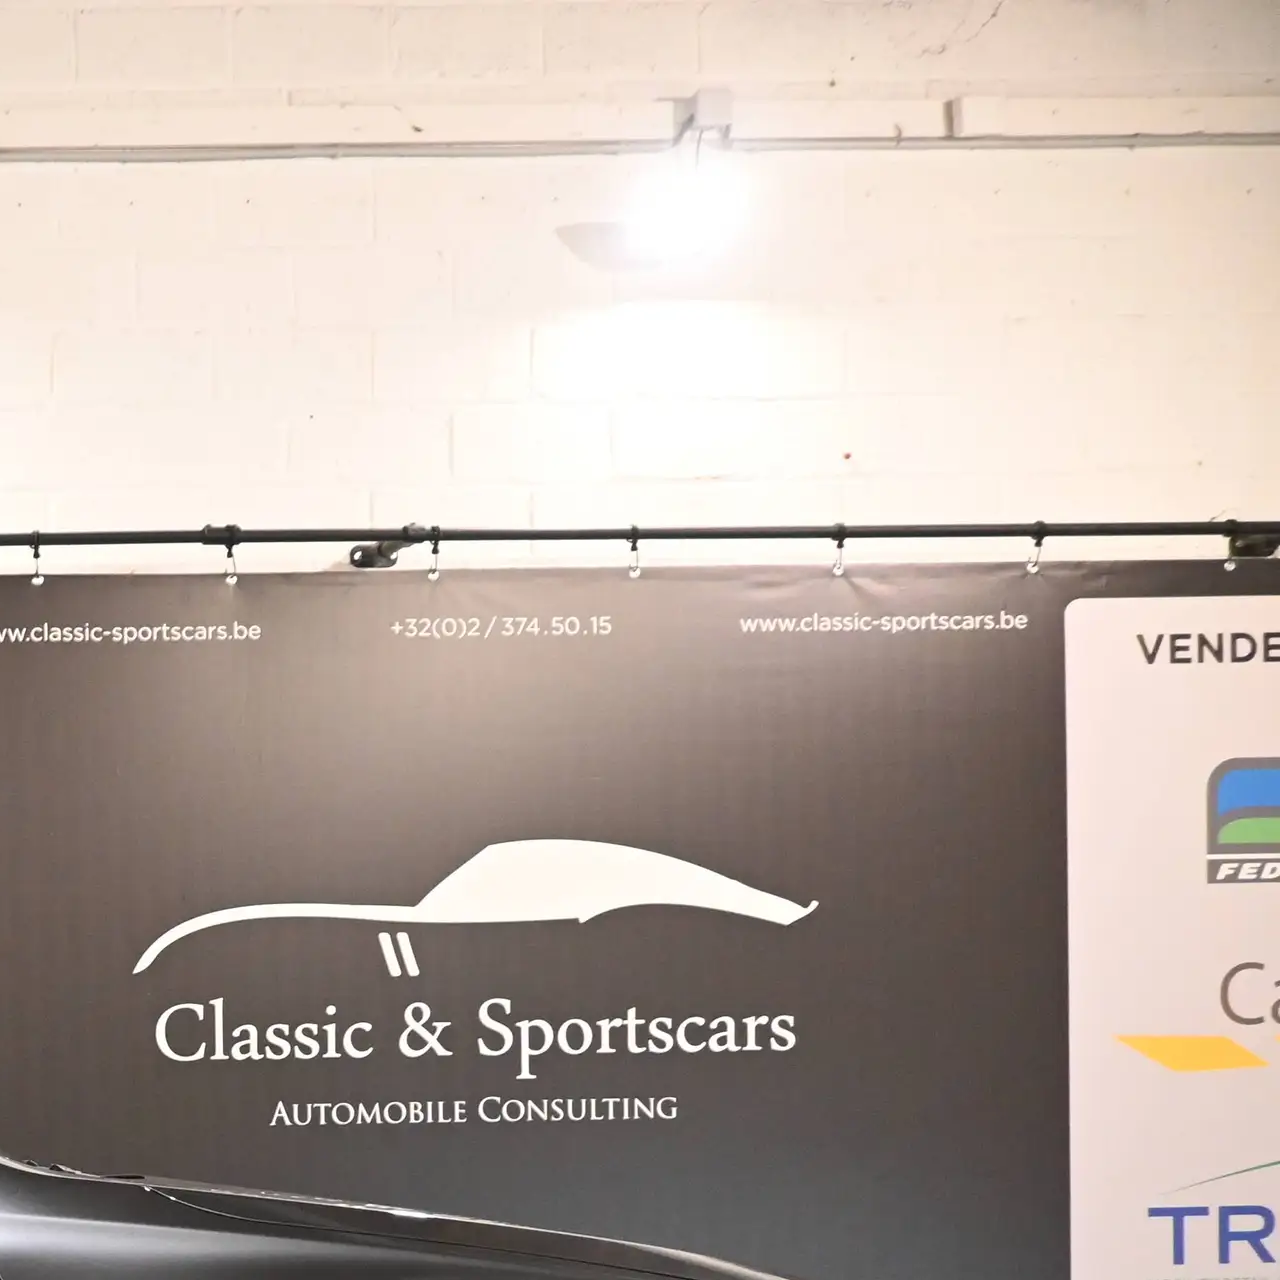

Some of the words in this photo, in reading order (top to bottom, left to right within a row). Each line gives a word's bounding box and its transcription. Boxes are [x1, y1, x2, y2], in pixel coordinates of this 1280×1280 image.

[390, 616, 481, 639] +32(0)2
[501, 615, 612, 637] 374.50.15
[739, 610, 1029, 634] www.classic-sportscars.be
[1136, 631, 1280, 665] VENDE
[155, 997, 374, 1062] Classic
[398, 1001, 454, 1058] &
[477, 997, 797, 1080] Sportscars
[269, 1100, 468, 1128] AUTOMOBILE
[477, 1095, 678, 1124] CONSULTING
